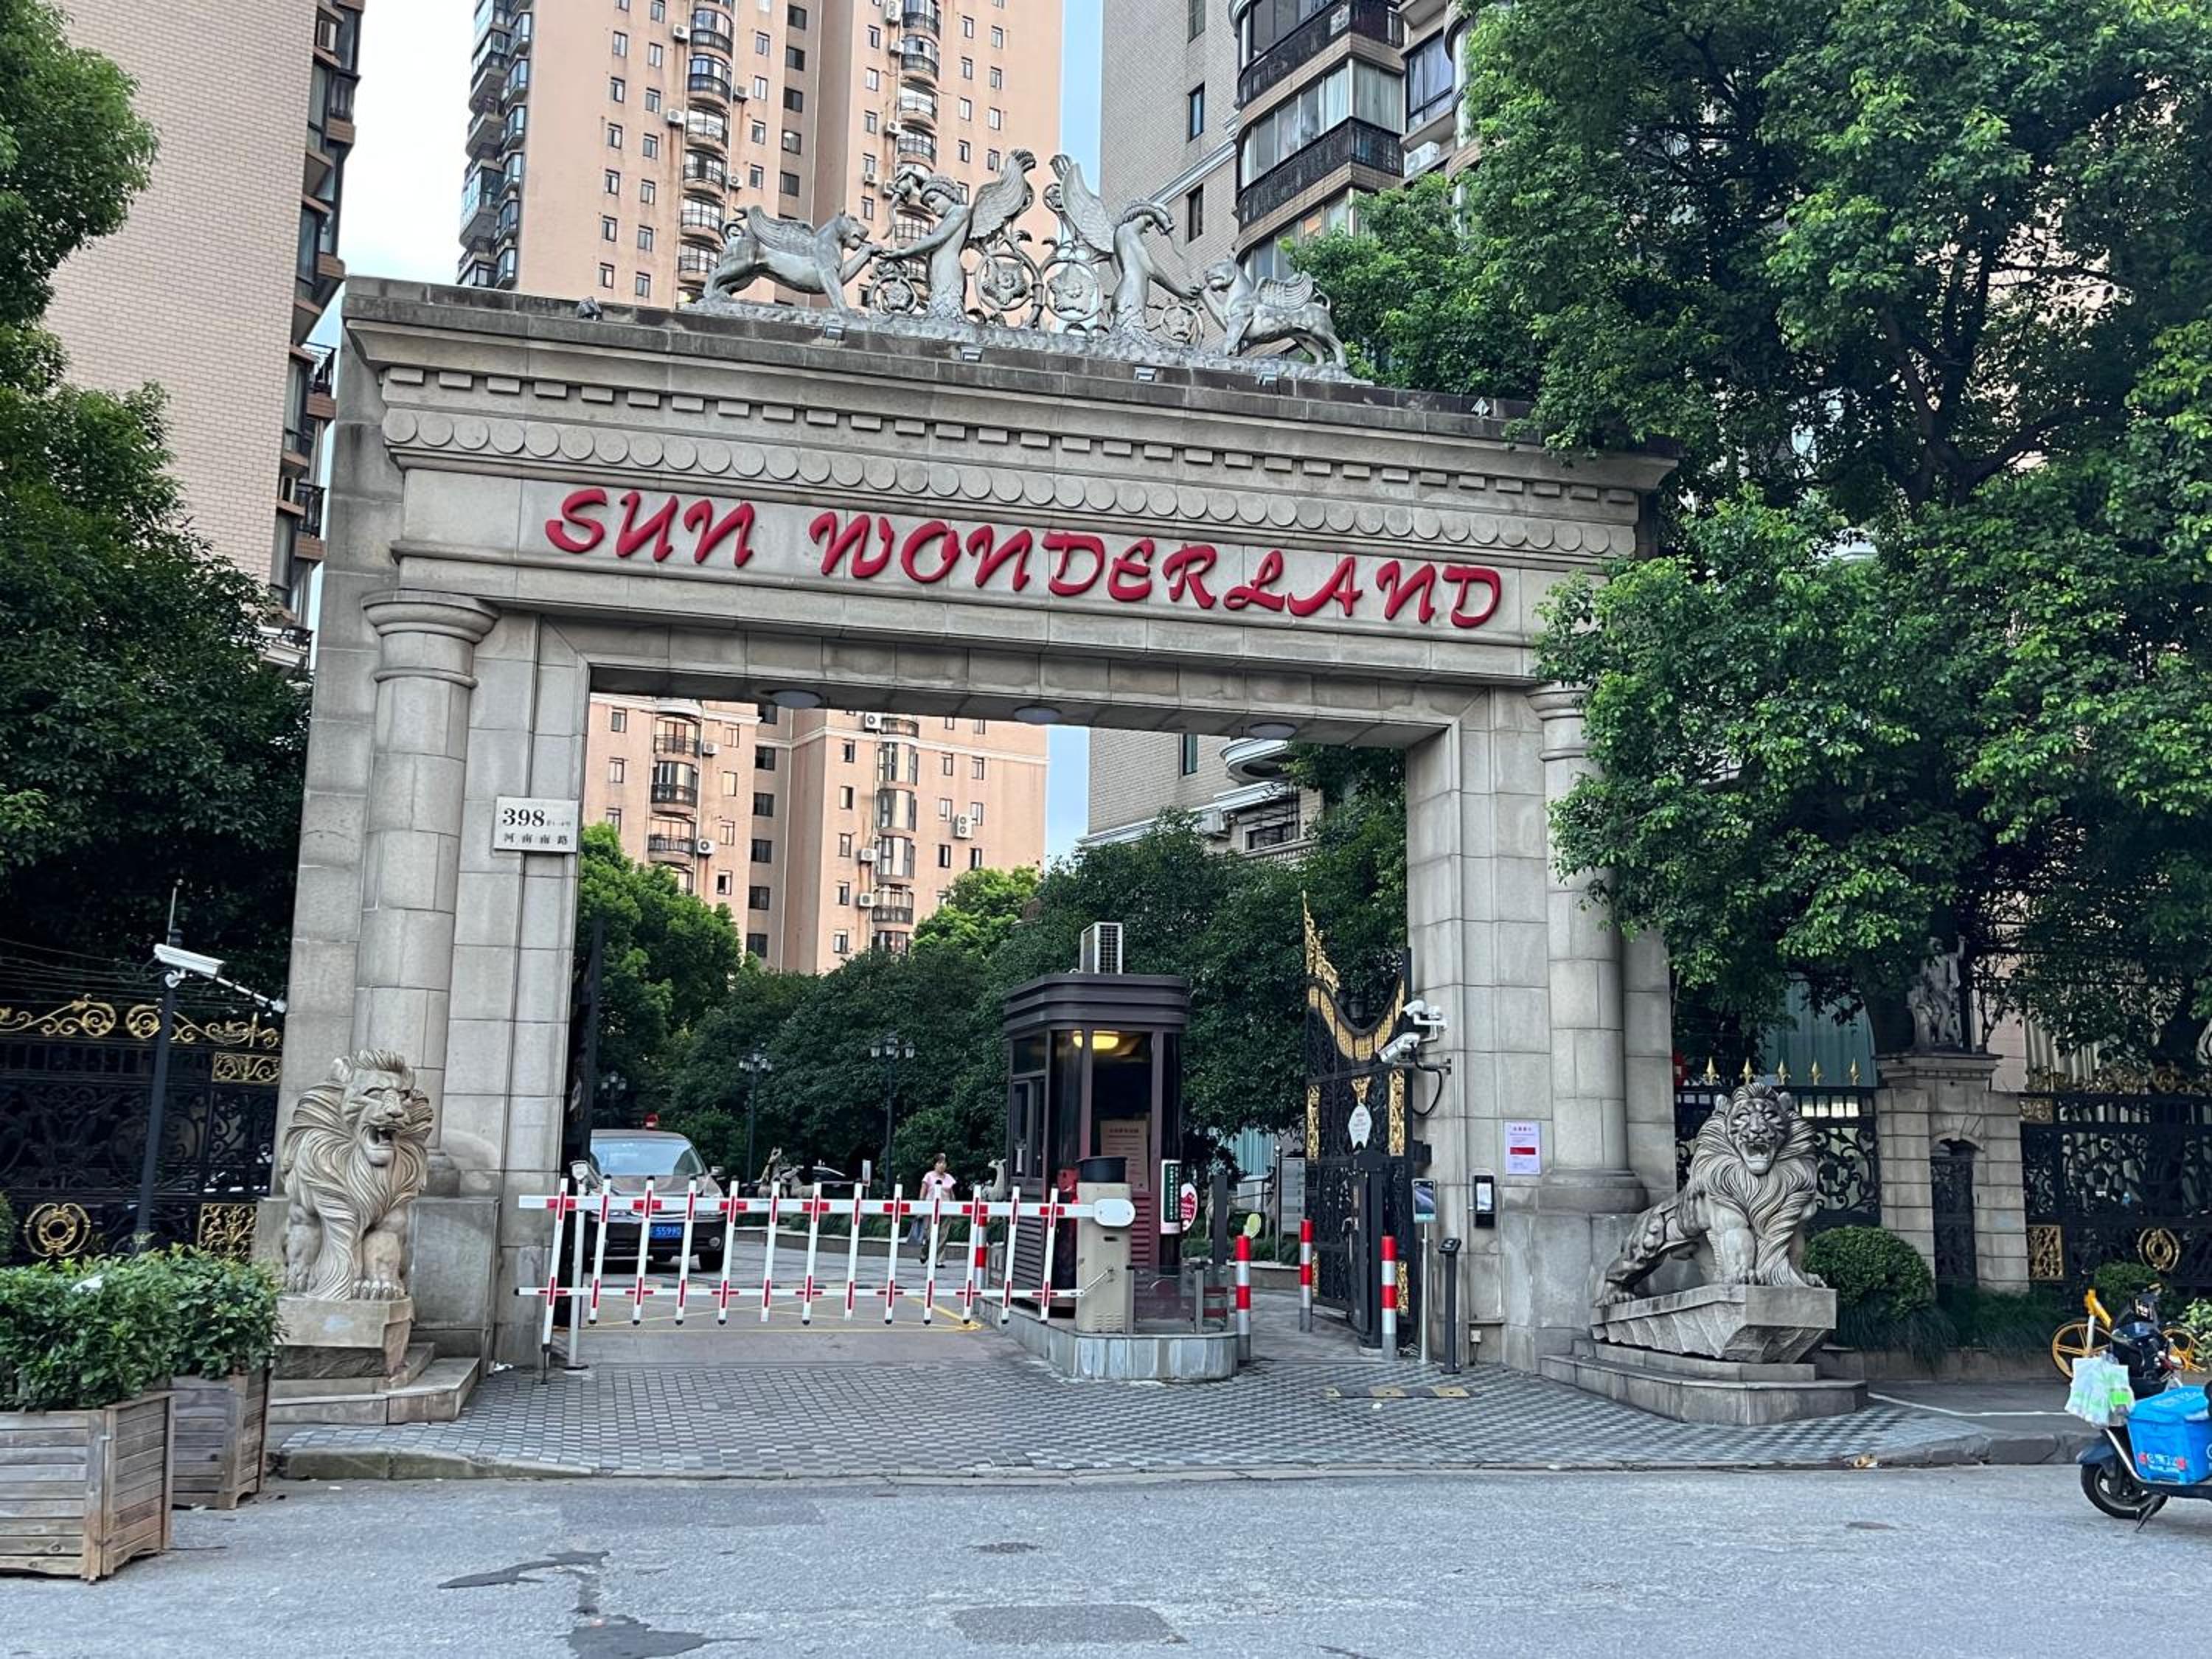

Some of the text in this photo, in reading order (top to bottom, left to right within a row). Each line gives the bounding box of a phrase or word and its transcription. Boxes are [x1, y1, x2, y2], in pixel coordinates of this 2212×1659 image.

[546, 488, 1501, 628] SUN WONDERLAND
[502, 807, 545, 827] 398
